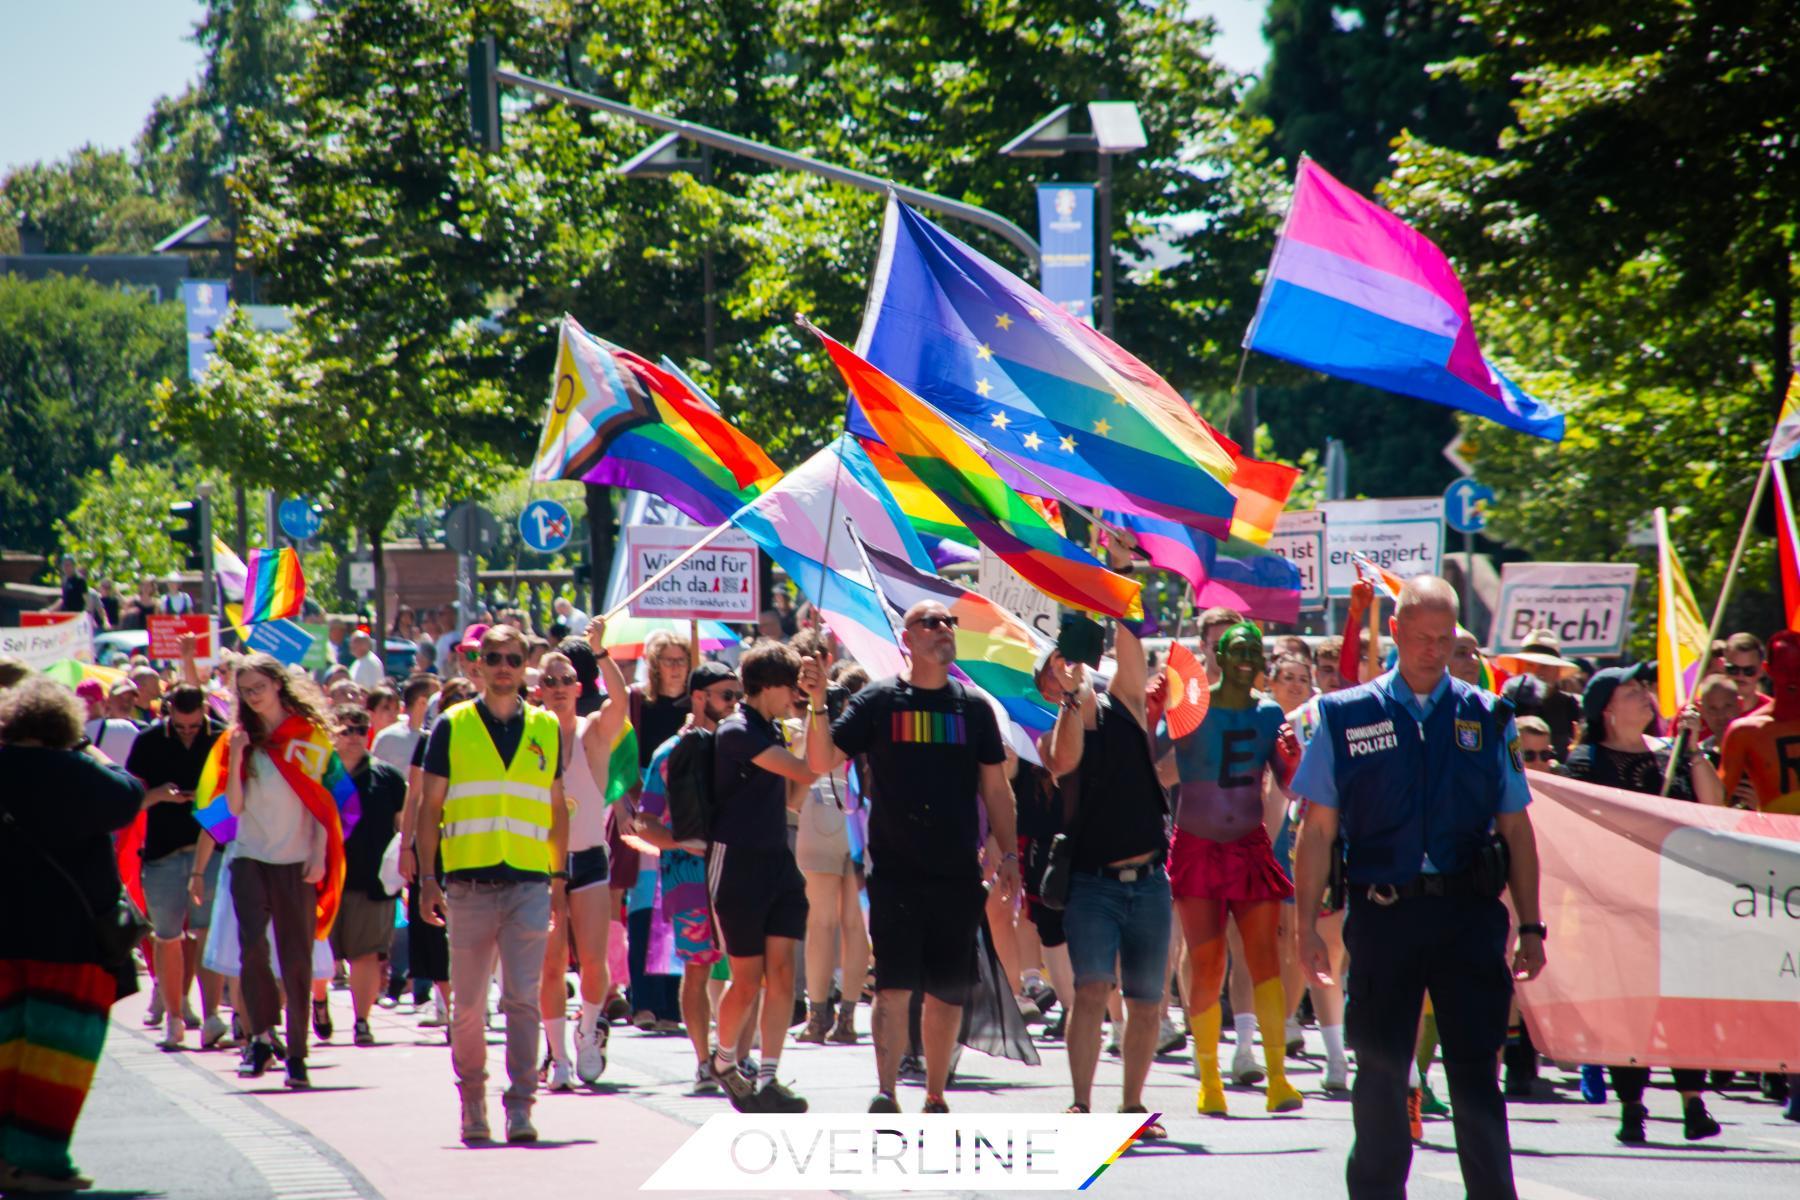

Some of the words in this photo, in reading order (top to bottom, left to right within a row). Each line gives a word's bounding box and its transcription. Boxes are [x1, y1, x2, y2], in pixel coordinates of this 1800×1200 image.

[1291, 541, 1314, 559] ist
[1330, 542, 1432, 569] enagiert.
[681, 555, 715, 571] sind
[721, 555, 747, 572] für
[1510, 608, 1611, 642] Bitch!
[1349, 733, 1398, 757] POLIZEI
[1218, 728, 1257, 789] E
[1780, 952, 1800, 978] A
